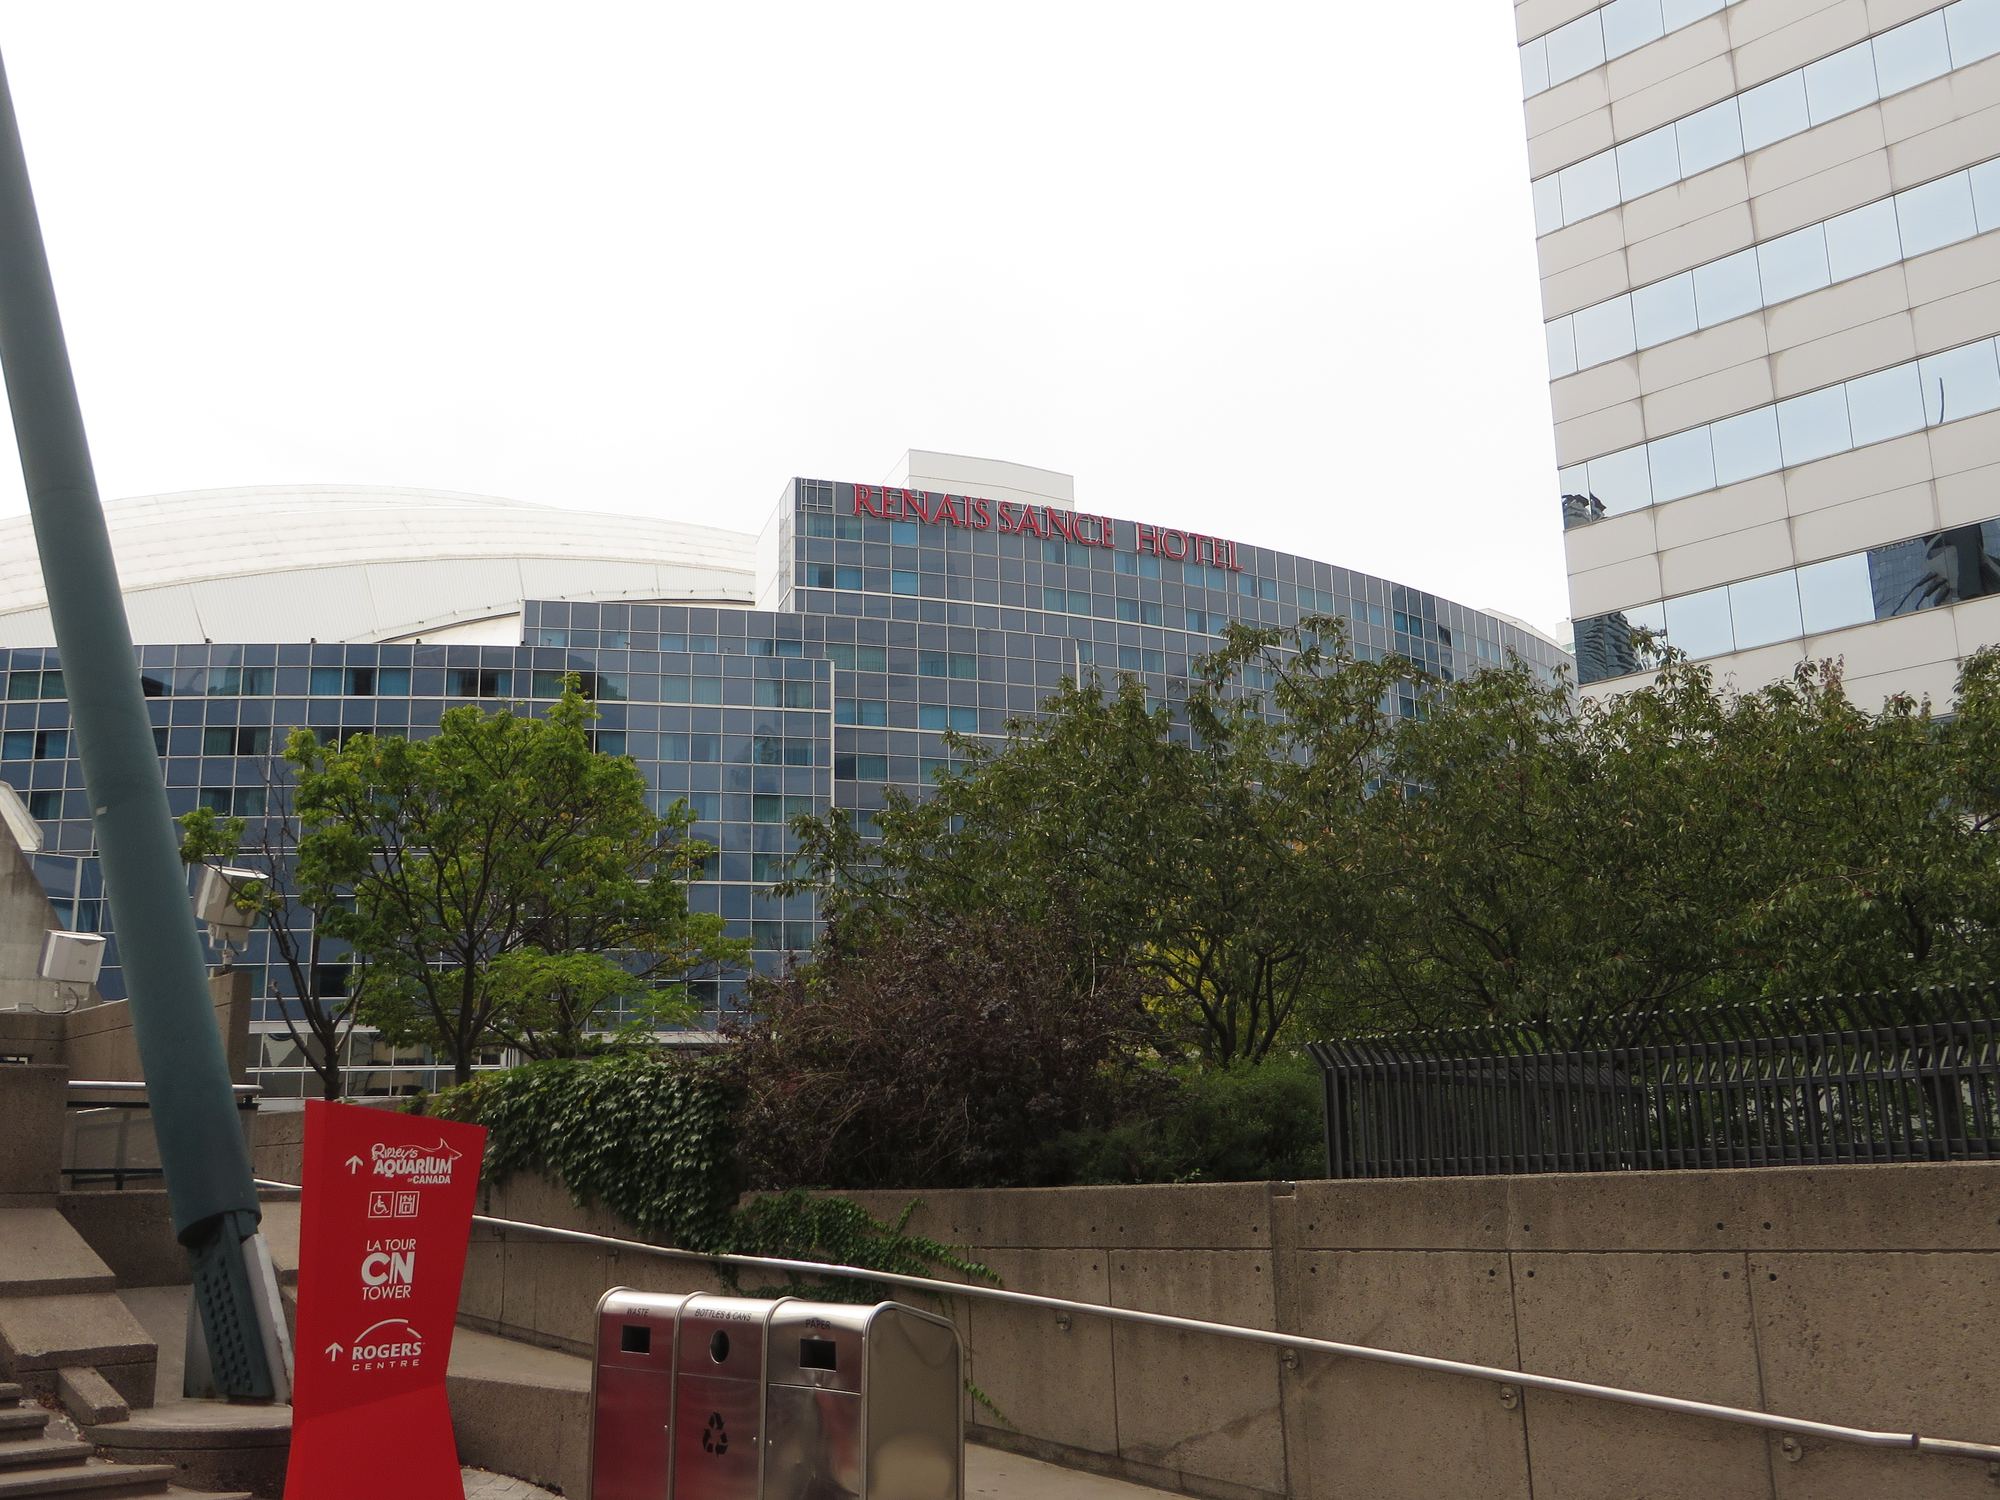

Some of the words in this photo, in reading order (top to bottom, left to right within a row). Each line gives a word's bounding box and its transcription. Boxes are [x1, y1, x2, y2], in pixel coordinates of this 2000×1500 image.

[853, 483, 1115, 549] RENAISSANCE
[1135, 521, 1243, 572] HOTEL
[373, 1156, 452, 1178] AQUARIUM
[412, 1174, 451, 1184] CANADA
[366, 1239, 382, 1252] LA
[385, 1238, 417, 1251] TOUR
[361, 1251, 415, 1286] CN
[362, 1284, 412, 1301] TOWER
[626, 1307, 649, 1317] WASTE
[694, 1308, 725, 1320] BOTTLES
[725, 1311, 731, 1320] &
[732, 1312, 751, 1322] CANS
[805, 1319, 831, 1330] PAPER
[352, 1341, 422, 1361] ROGERS
[352, 1359, 420, 1371] CENTRE
